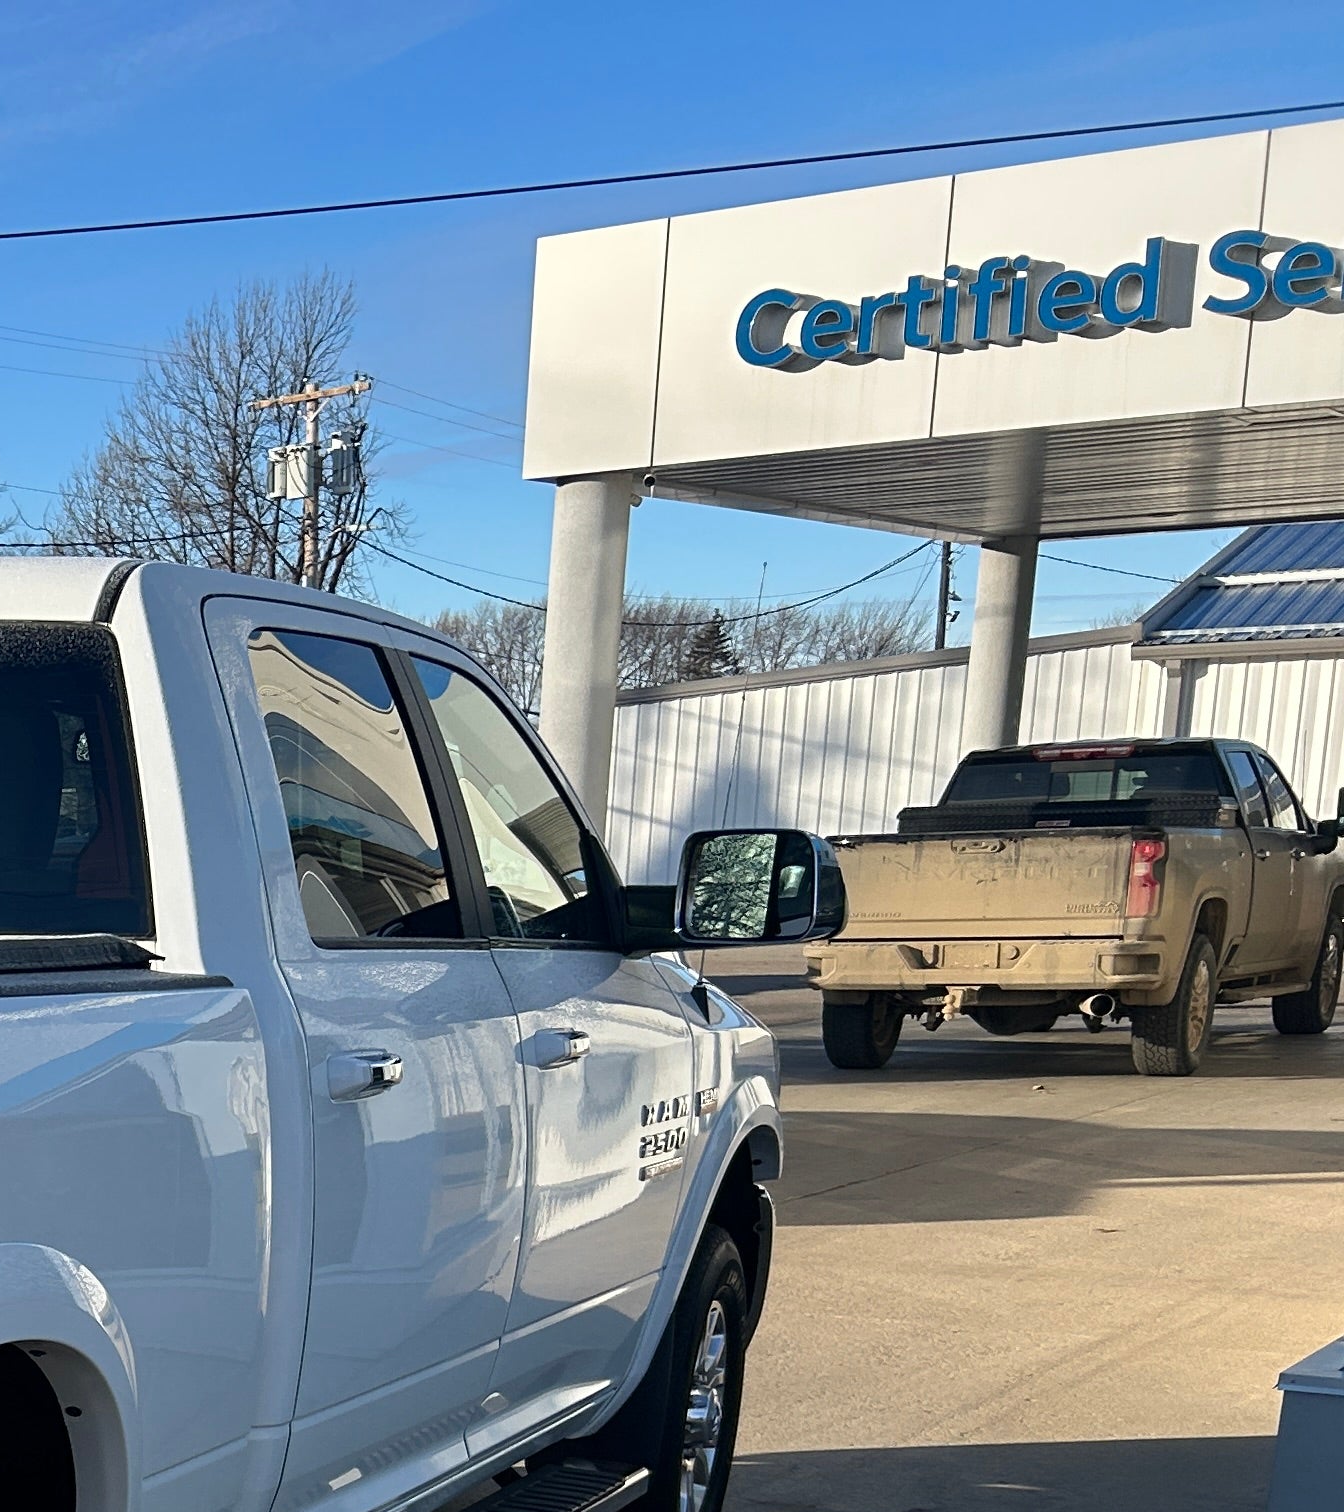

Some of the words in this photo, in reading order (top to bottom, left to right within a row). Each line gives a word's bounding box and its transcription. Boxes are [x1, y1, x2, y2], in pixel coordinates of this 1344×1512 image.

[735, 236, 1166, 368] Certified
[1202, 229, 1344, 316] Se
[639, 1126, 688, 1158] 2500
